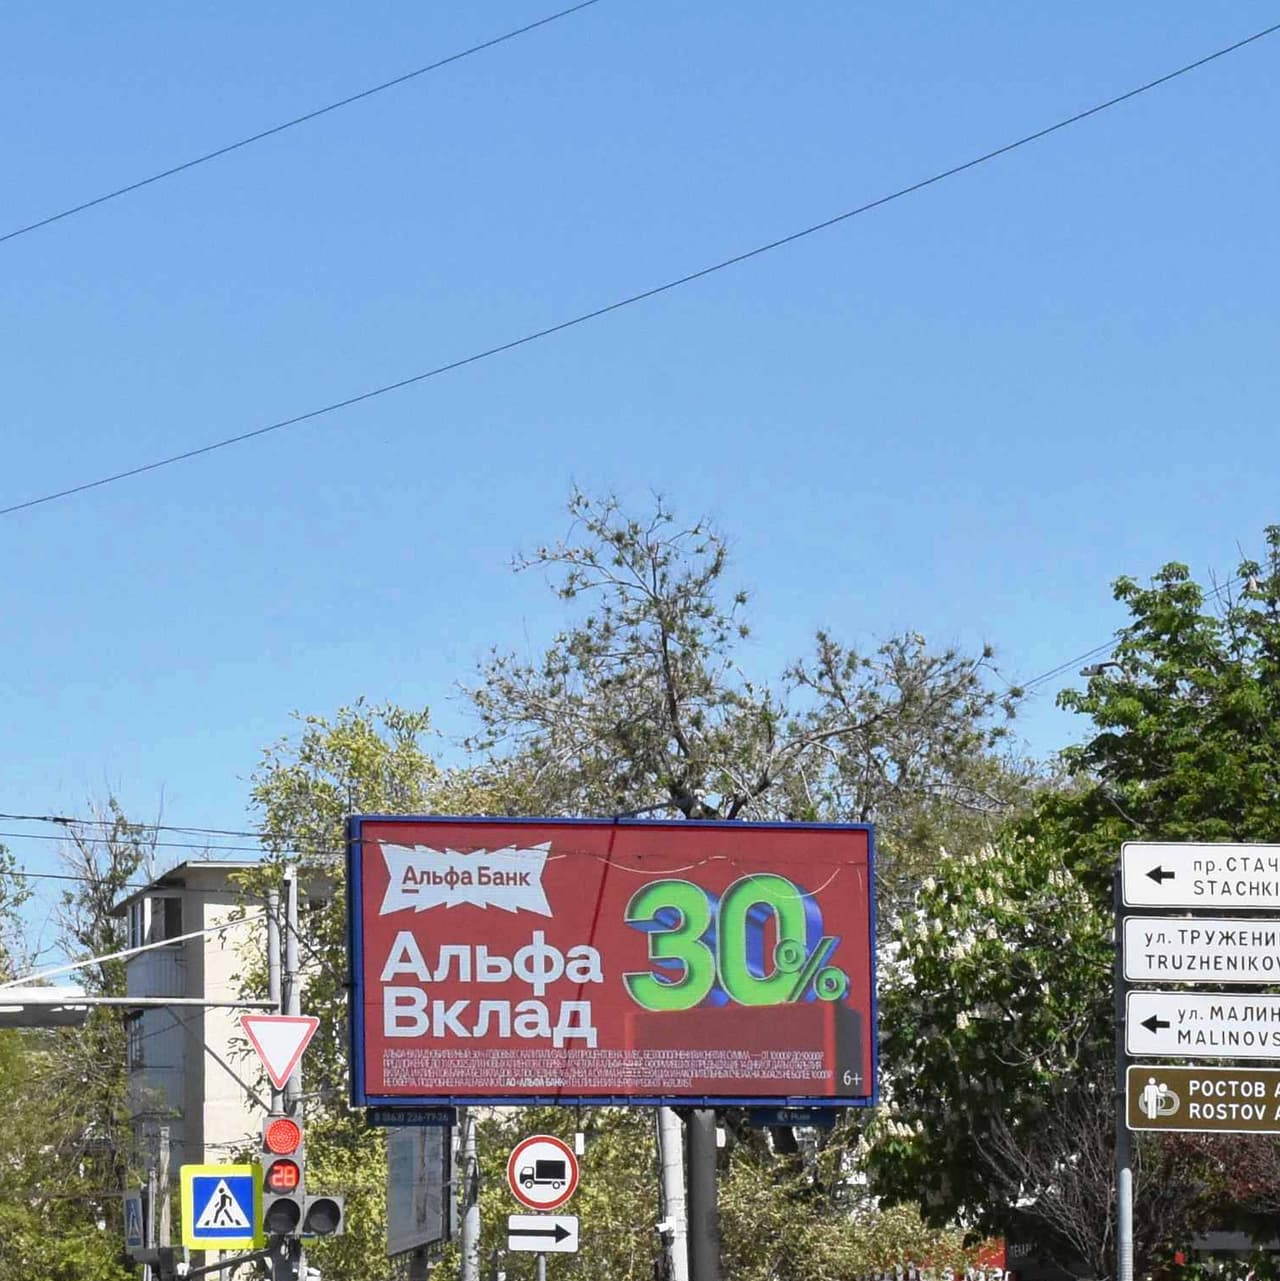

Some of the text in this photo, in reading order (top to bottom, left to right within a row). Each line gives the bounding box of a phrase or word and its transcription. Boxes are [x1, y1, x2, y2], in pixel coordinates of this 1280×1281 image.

[402, 865, 530, 889] Альфа Банк
[1193, 881, 1279, 897] STACHKI
[623, 872, 850, 1012] 30%
[380, 930, 604, 996] Альфа
[382, 986, 597, 1048] Вклад
[842, 1069, 863, 1087] 6+
[1189, 1080, 1266, 1099] РОСТОВ
[1189, 1103, 1266, 1121] ROSTOV
[271, 1165, 295, 1187] 28
